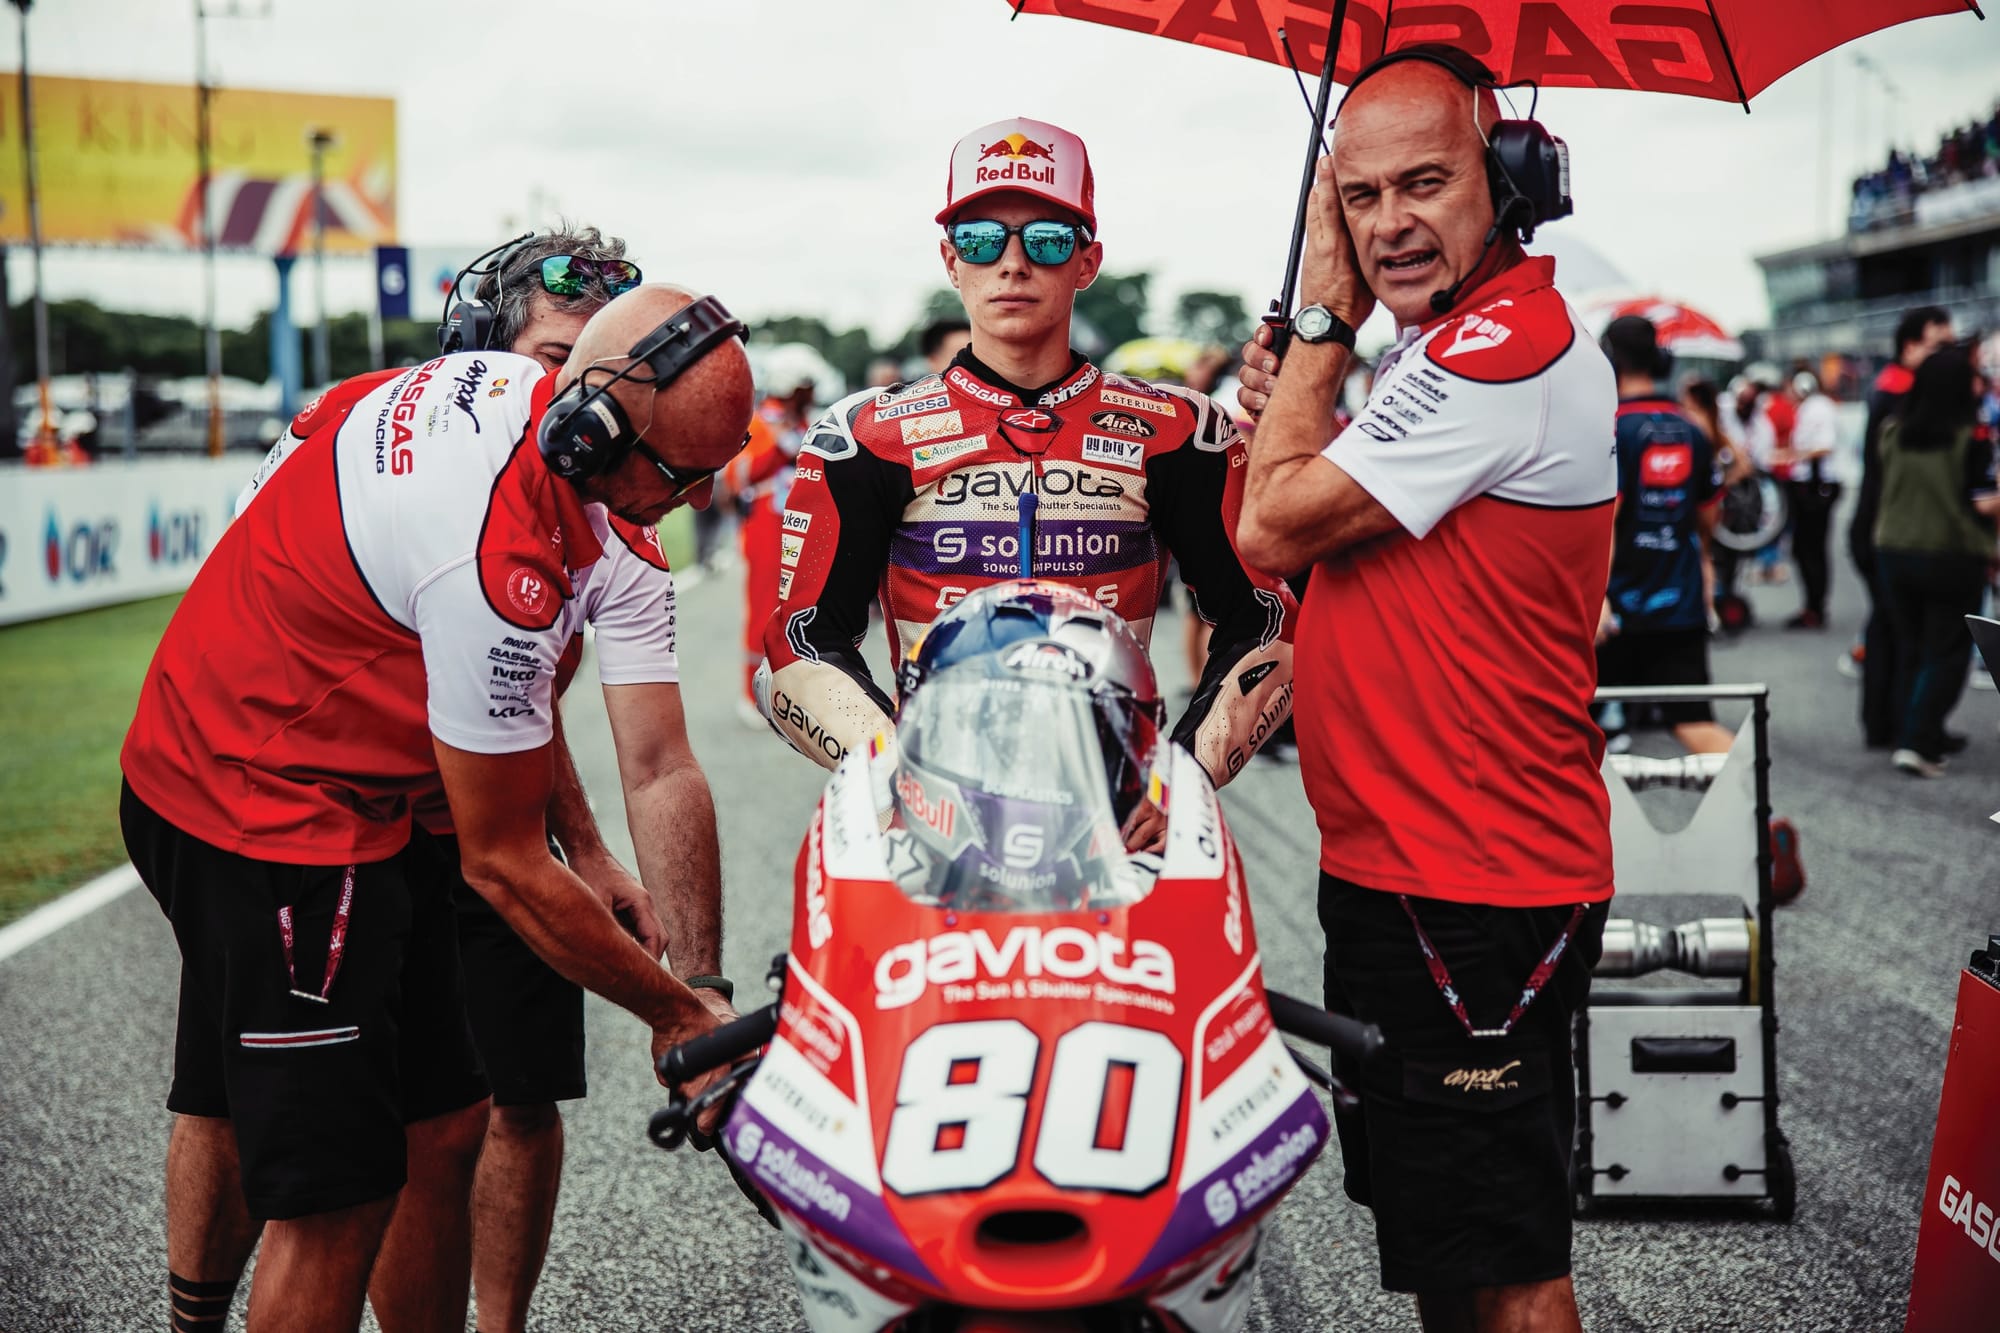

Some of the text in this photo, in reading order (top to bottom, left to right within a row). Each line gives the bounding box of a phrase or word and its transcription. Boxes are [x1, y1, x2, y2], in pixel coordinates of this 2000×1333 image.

[976, 162, 1055, 185] Red Bull
[950, 370, 1013, 407] GASGAS
[1102, 394, 1163, 413] ASTERIUS
[391, 357, 447, 476] GASGAS
[877, 396, 949, 420] valresa
[1096, 413, 1150, 436] Airoh
[375, 408, 390, 474] RACING
[931, 437, 984, 456] AutoSolar
[981, 502, 1000, 511] The
[1073, 501, 1122, 512] Specialists
[980, 526, 1120, 558] sounion
[492, 665, 537, 682] IVECO
[1005, 642, 1086, 679] Airoh
[911, 783, 956, 839] Bull
[979, 861, 1057, 891] solunion
[338, 876, 353, 917] MotoGP
[873, 925, 1177, 1011] gaviota
[943, 978, 1177, 1015] The Sun & Shutter Specialists
[1443, 1059, 1521, 1092] aspar
[879, 1018, 1186, 1199] 80
[1232, 1123, 1319, 1200] solunion
[757, 1140, 851, 1222] solunion
